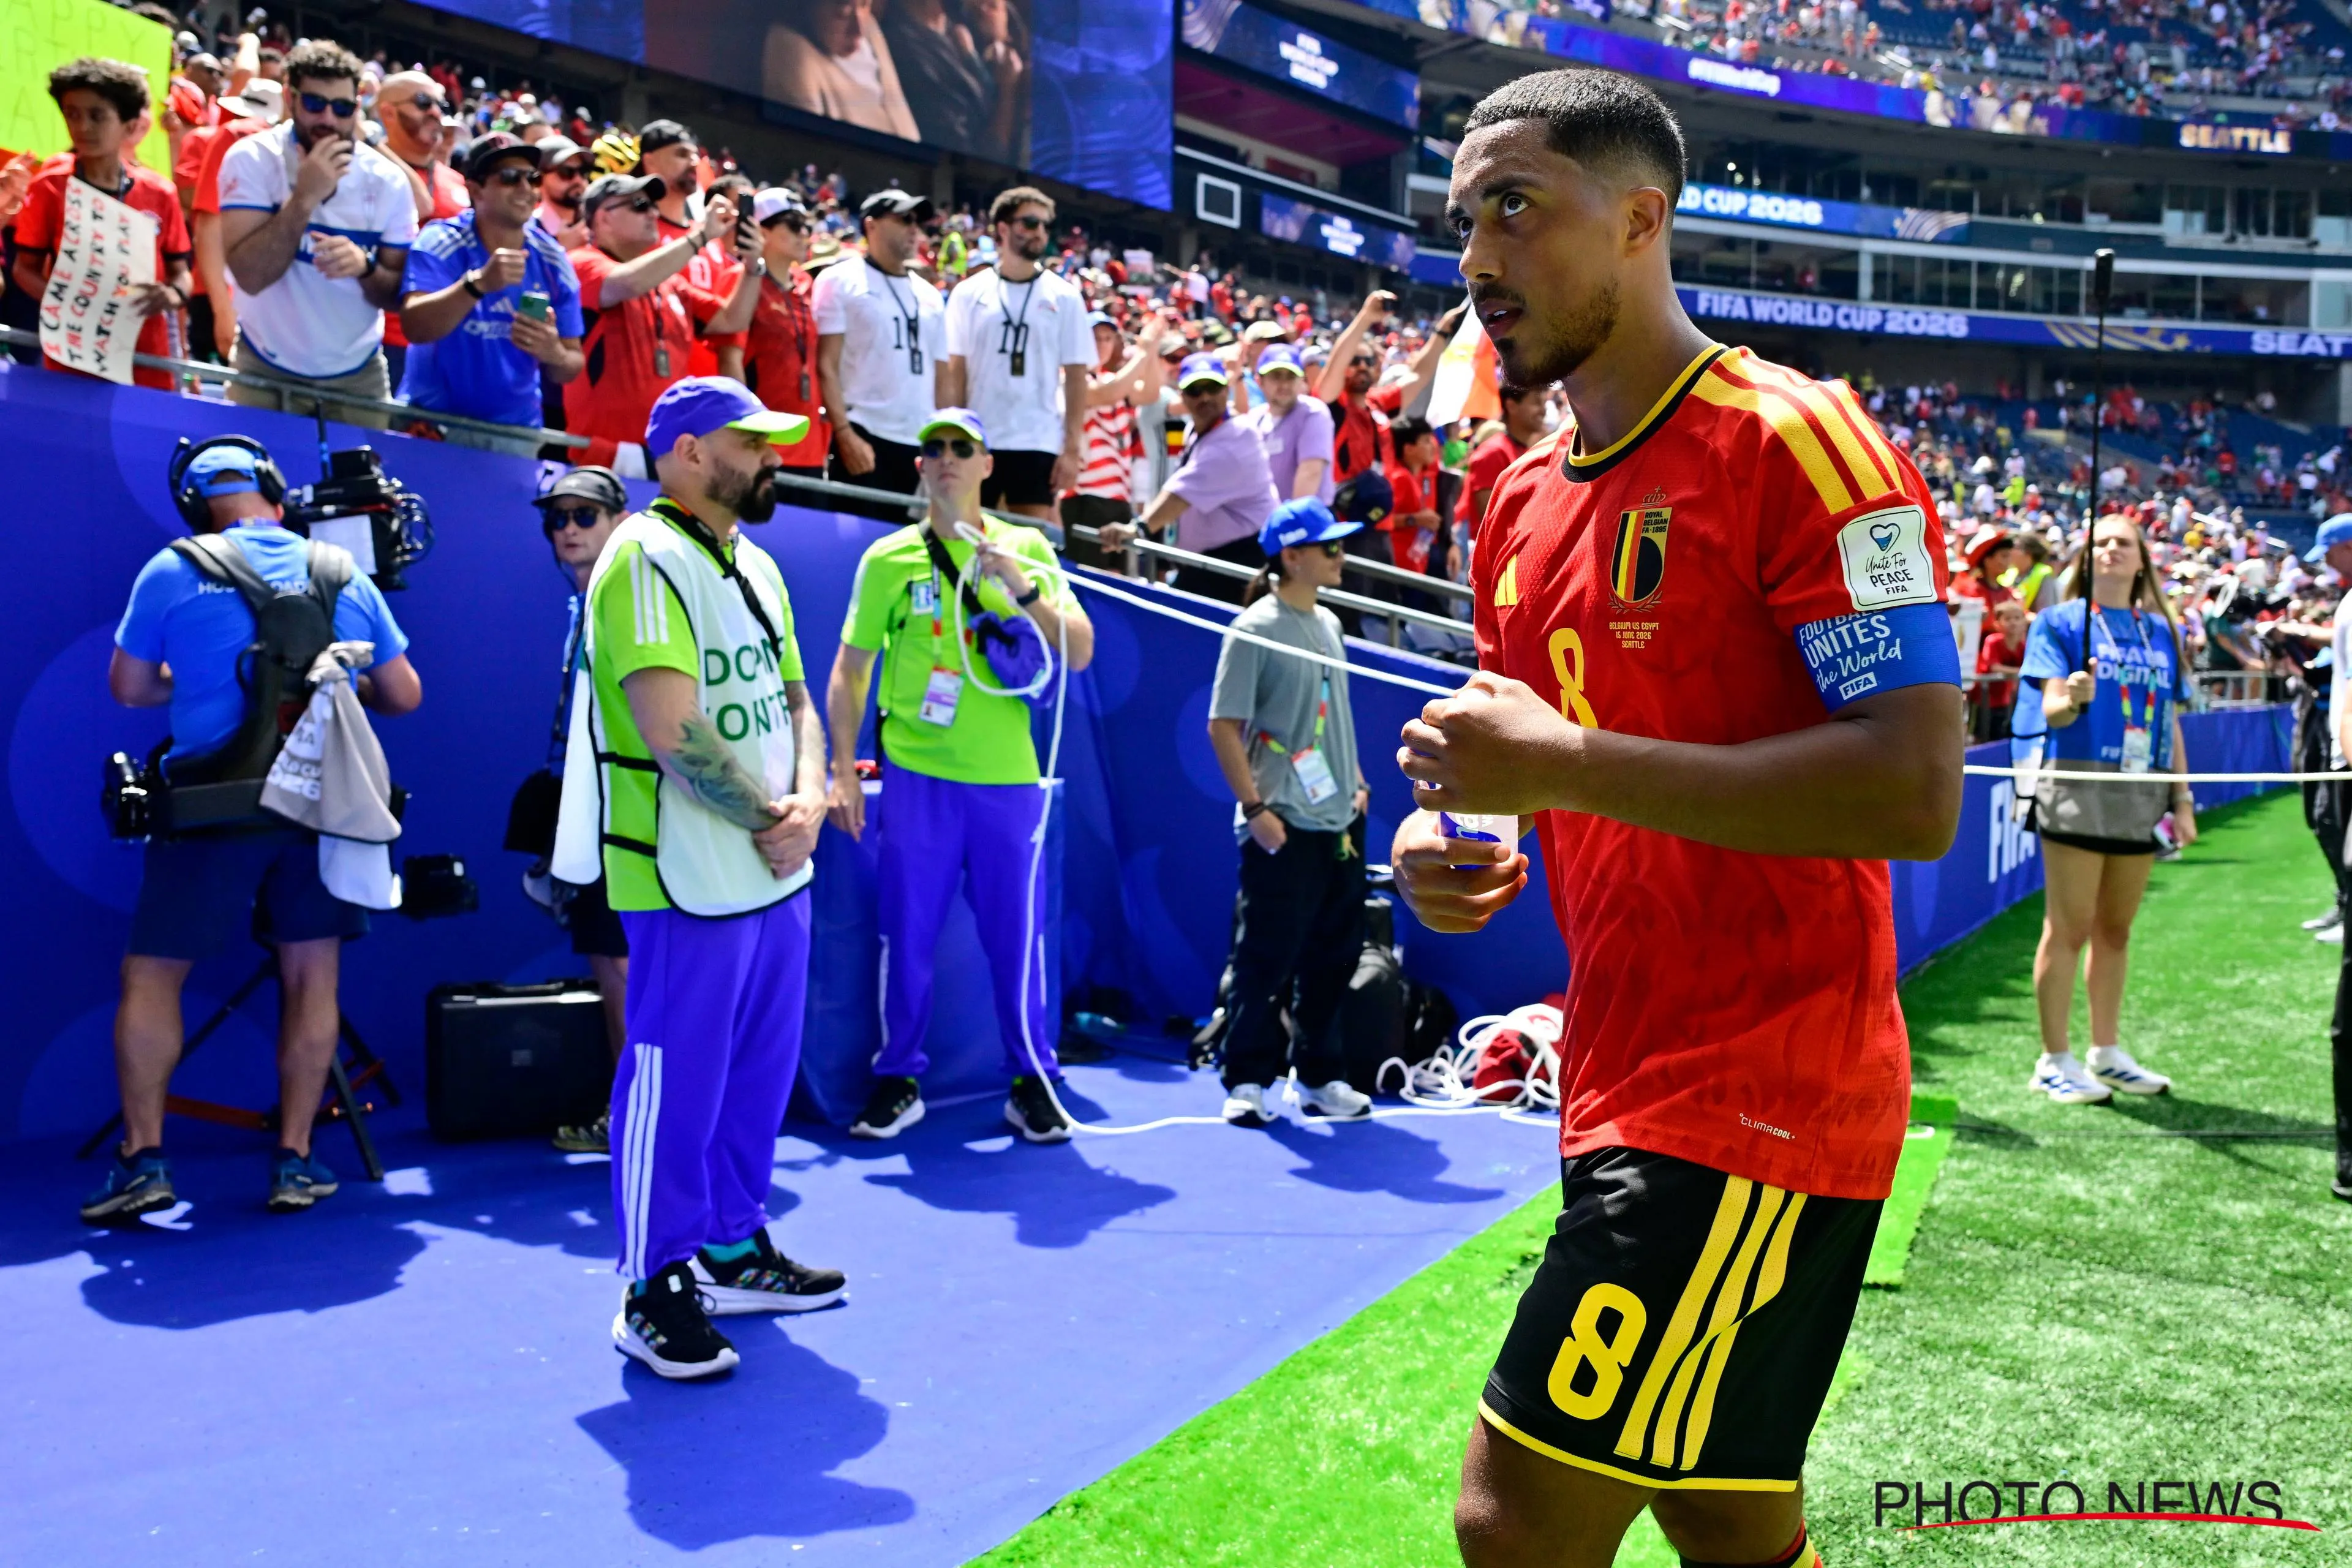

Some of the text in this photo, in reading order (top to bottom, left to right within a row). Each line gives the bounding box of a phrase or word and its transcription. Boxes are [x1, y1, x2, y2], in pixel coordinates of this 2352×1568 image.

[2179, 123, 2291, 154] SEATTLE
[1703, 187, 1748, 216] CUP
[1747, 193, 1823, 226] 2026
[40, 267, 73, 331] CAME
[66, 196, 106, 366] THE COUNTRY TO
[1696, 292, 1970, 338] FIFA WORLD CUP 2026
[94, 301, 119, 372] WATCH
[1866, 552, 1907, 575] Unite For
[1869, 568, 1914, 587] PEACE
[1885, 585, 1909, 595] FIFA
[1609, 622, 1632, 630] BELGIUM
[1641, 622, 1659, 630] EGYPT
[1621, 640, 1645, 649] SEATTLE
[1799, 609, 1885, 646] FOOTB
[1804, 614, 1891, 669] UNITES
[1816, 638, 1902, 693] the World
[1842, 676, 1874, 697] FIFA
[1547, 1283, 1647, 1420] 8
